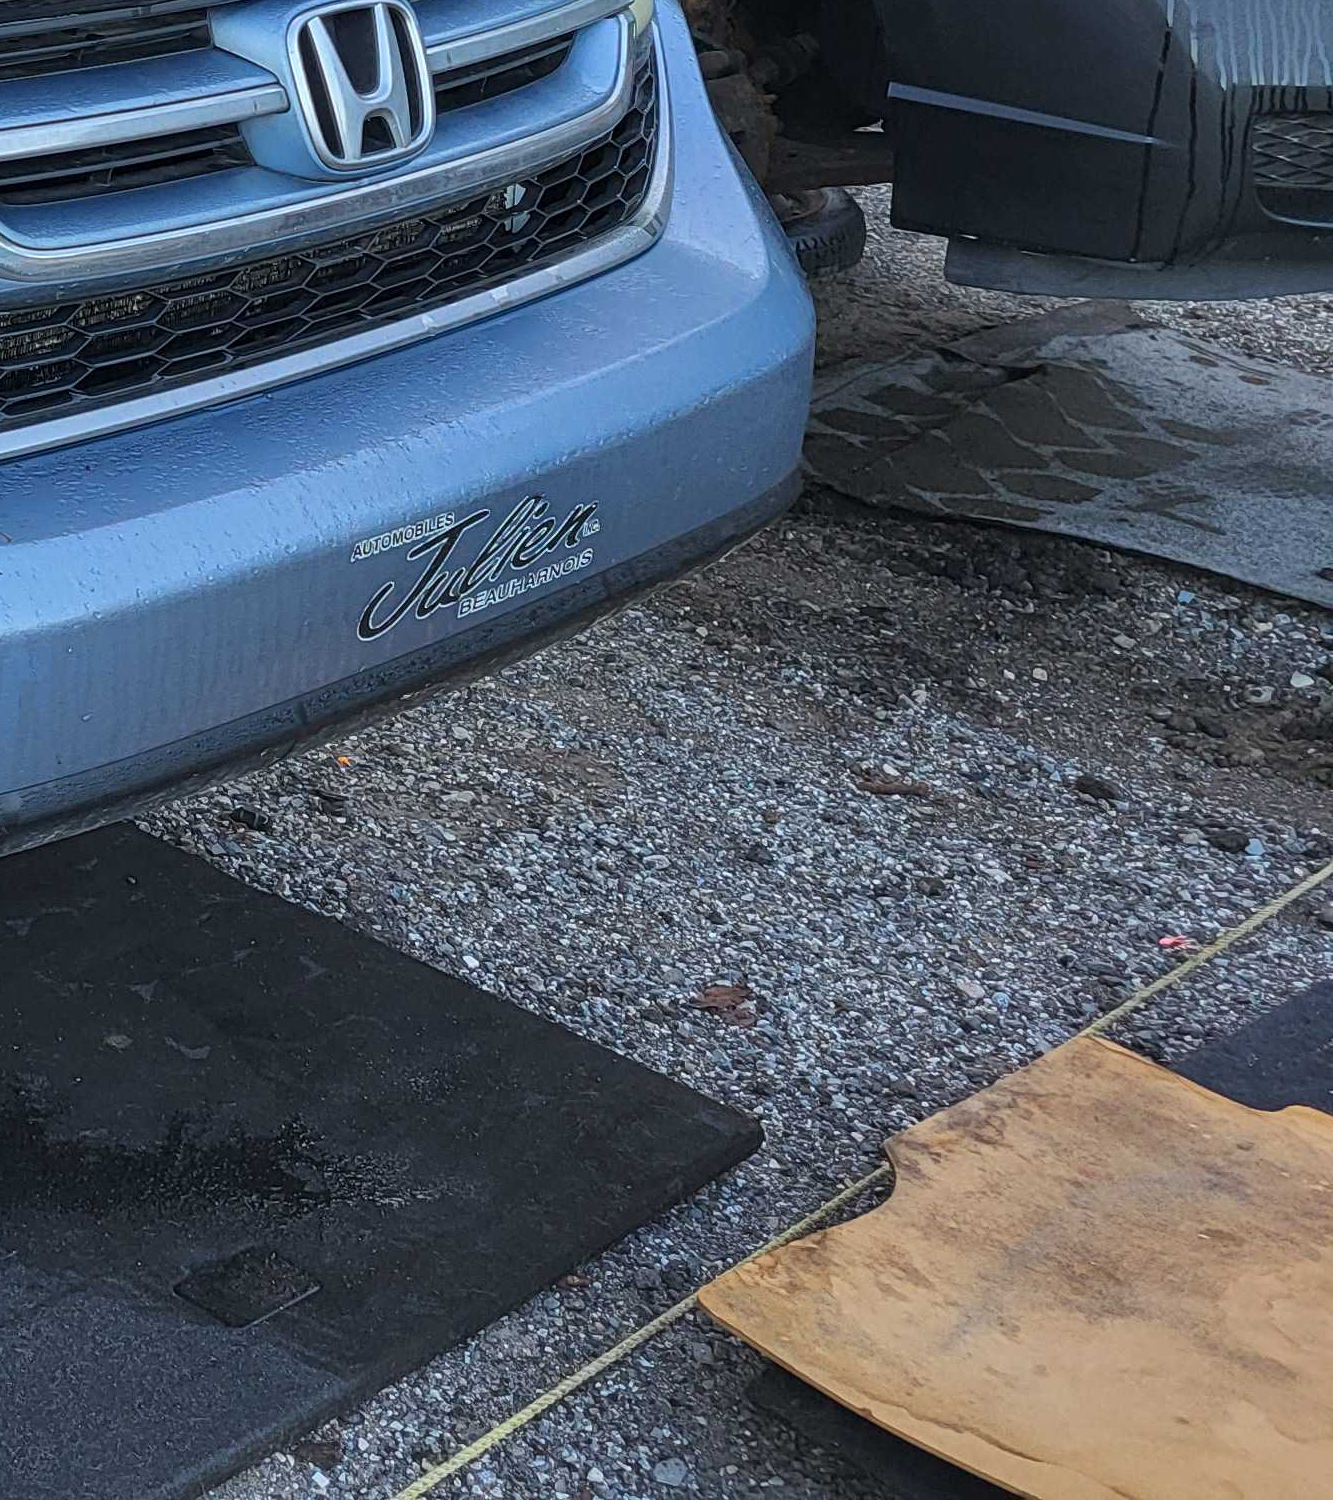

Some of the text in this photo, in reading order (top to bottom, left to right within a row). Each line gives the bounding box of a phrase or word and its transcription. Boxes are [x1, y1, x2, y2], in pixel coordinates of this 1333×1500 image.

[350, 511, 455, 563] AUTOMOBILES
[356, 494, 600, 642] Julien
[456, 547, 594, 620] BEAUHARNOIS
